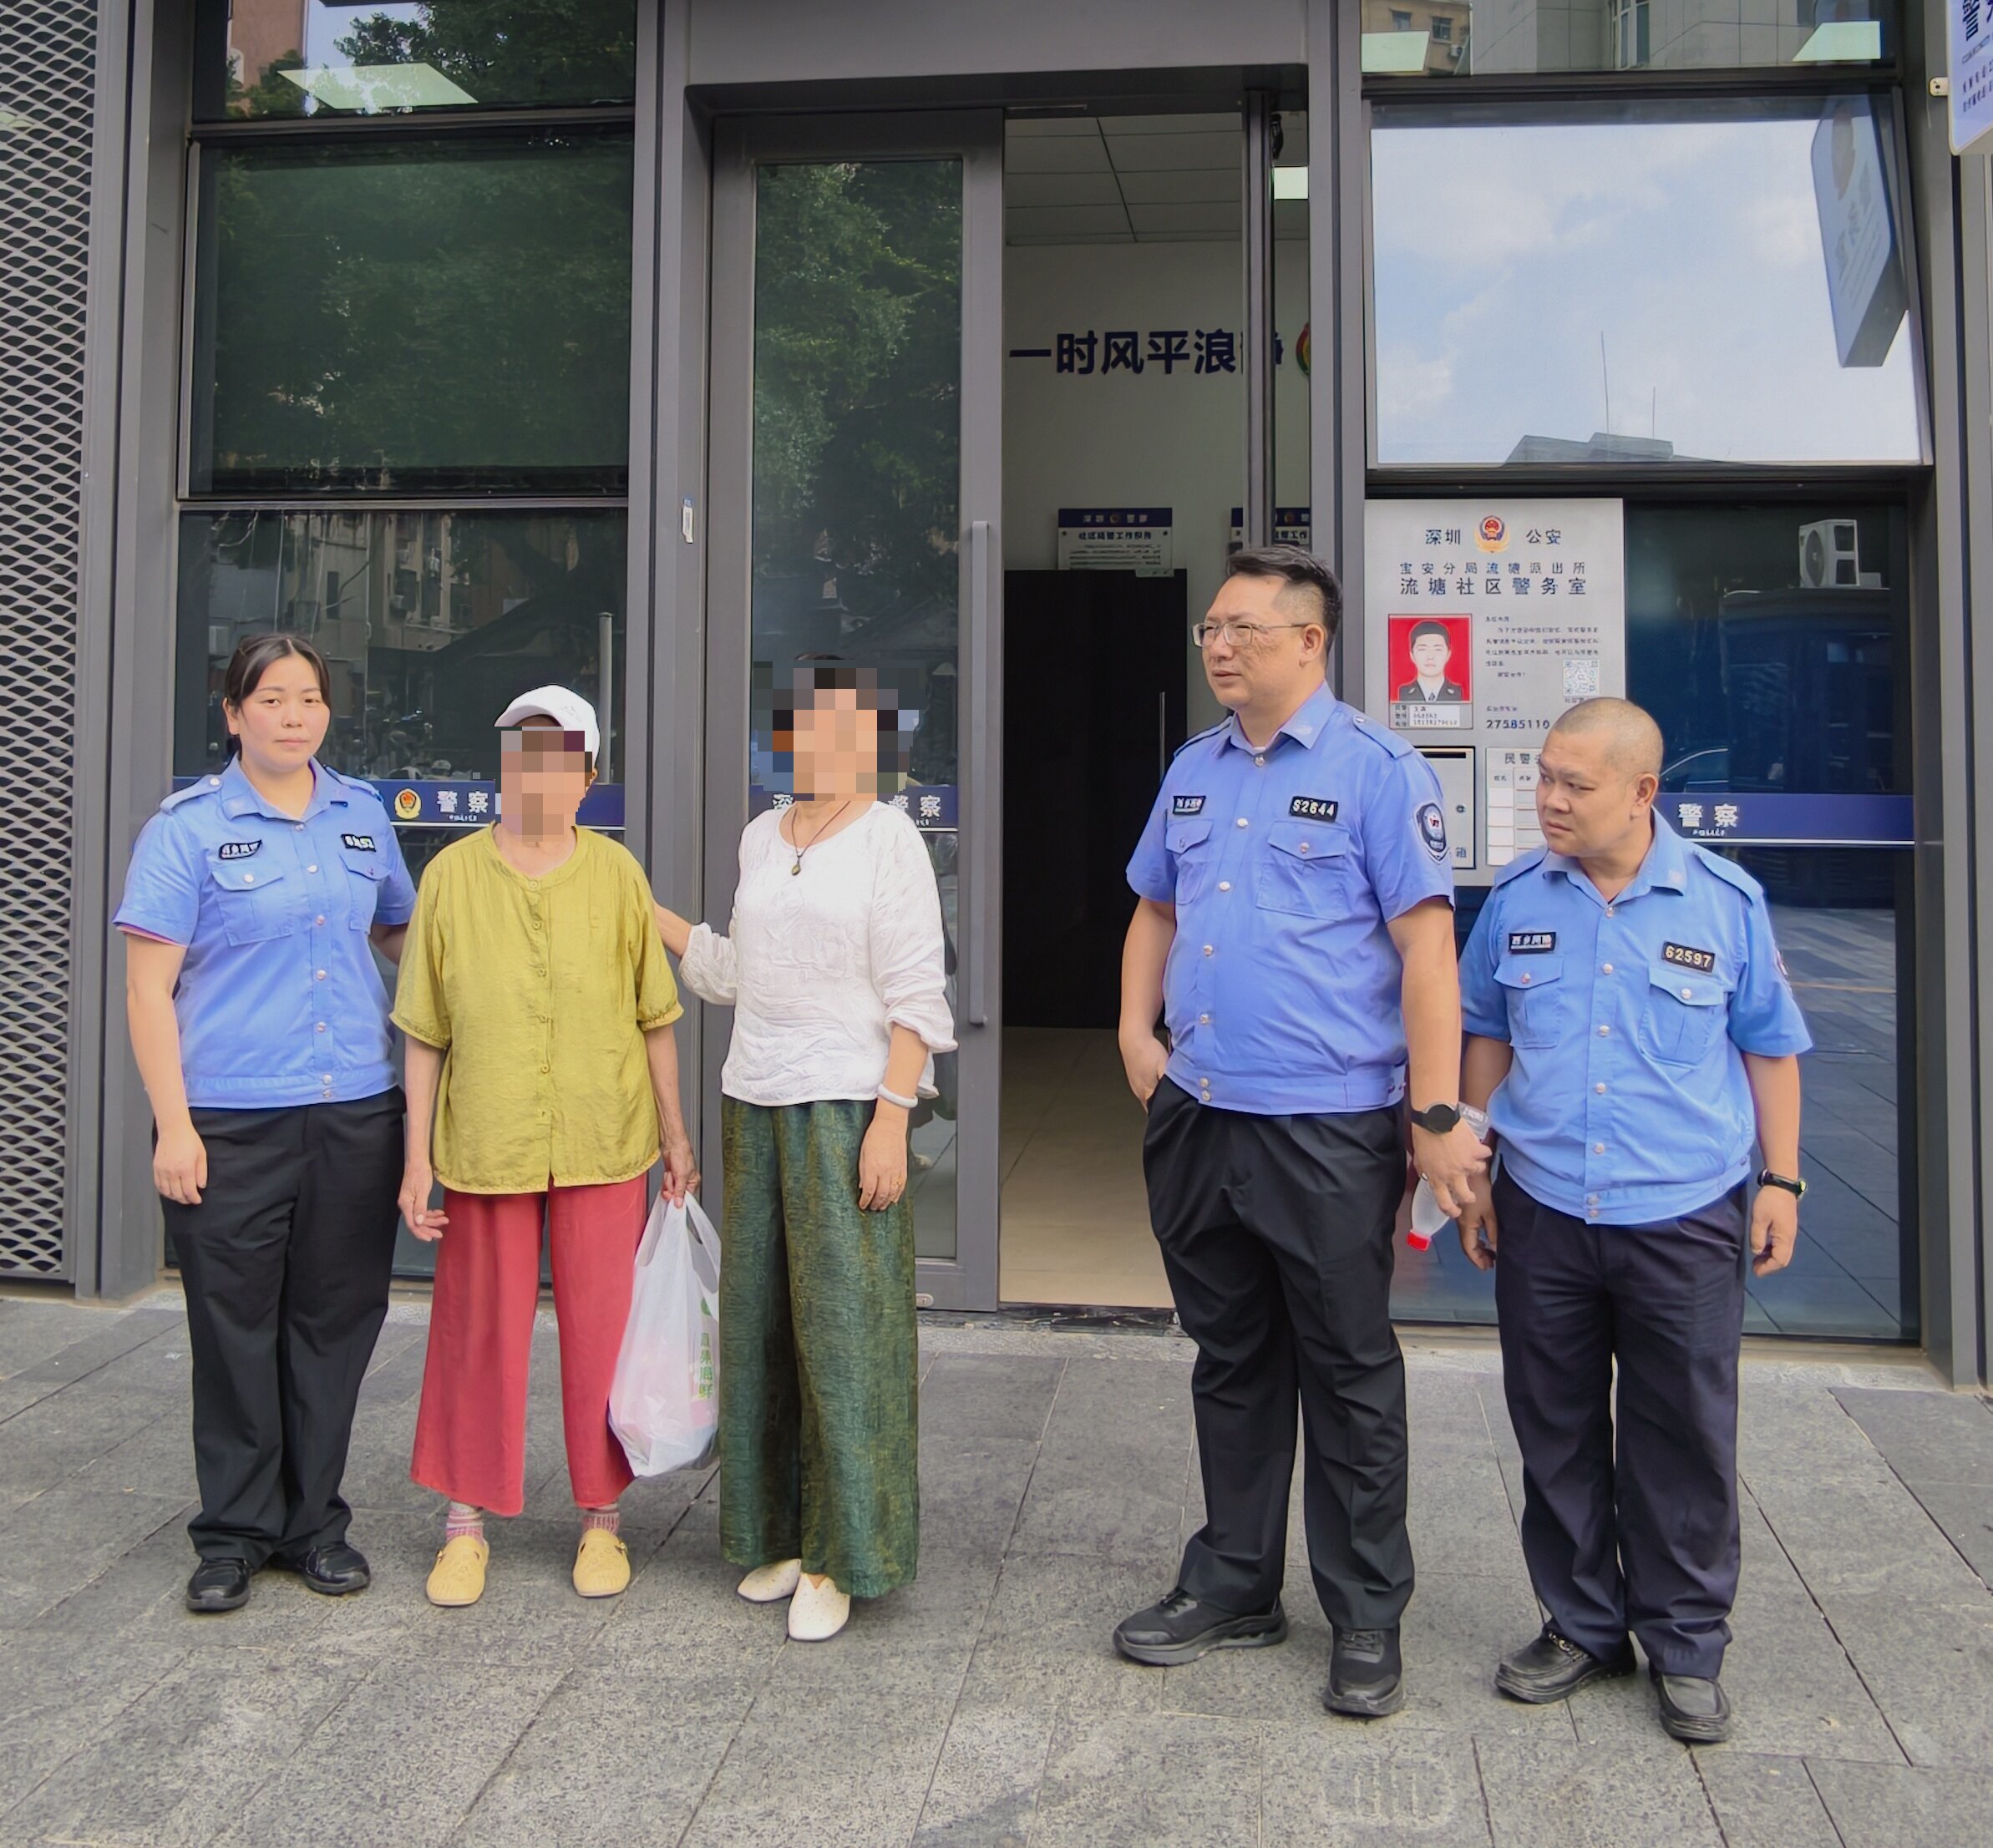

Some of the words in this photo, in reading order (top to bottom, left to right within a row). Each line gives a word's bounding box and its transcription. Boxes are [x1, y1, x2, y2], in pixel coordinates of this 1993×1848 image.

[1425, 529, 1461, 545] 深圳
[1526, 529, 1561, 545] 公安
[1400, 562, 1585, 575] 宝安分局流塘派出所
[1401, 578, 1586, 595] 流塘社区警务室
[1486, 720, 1550, 730] 27585110
[437, 791, 489, 813] 警察
[1678, 803, 1739, 828] 警察
[1665, 944, 1712, 968] 62597
